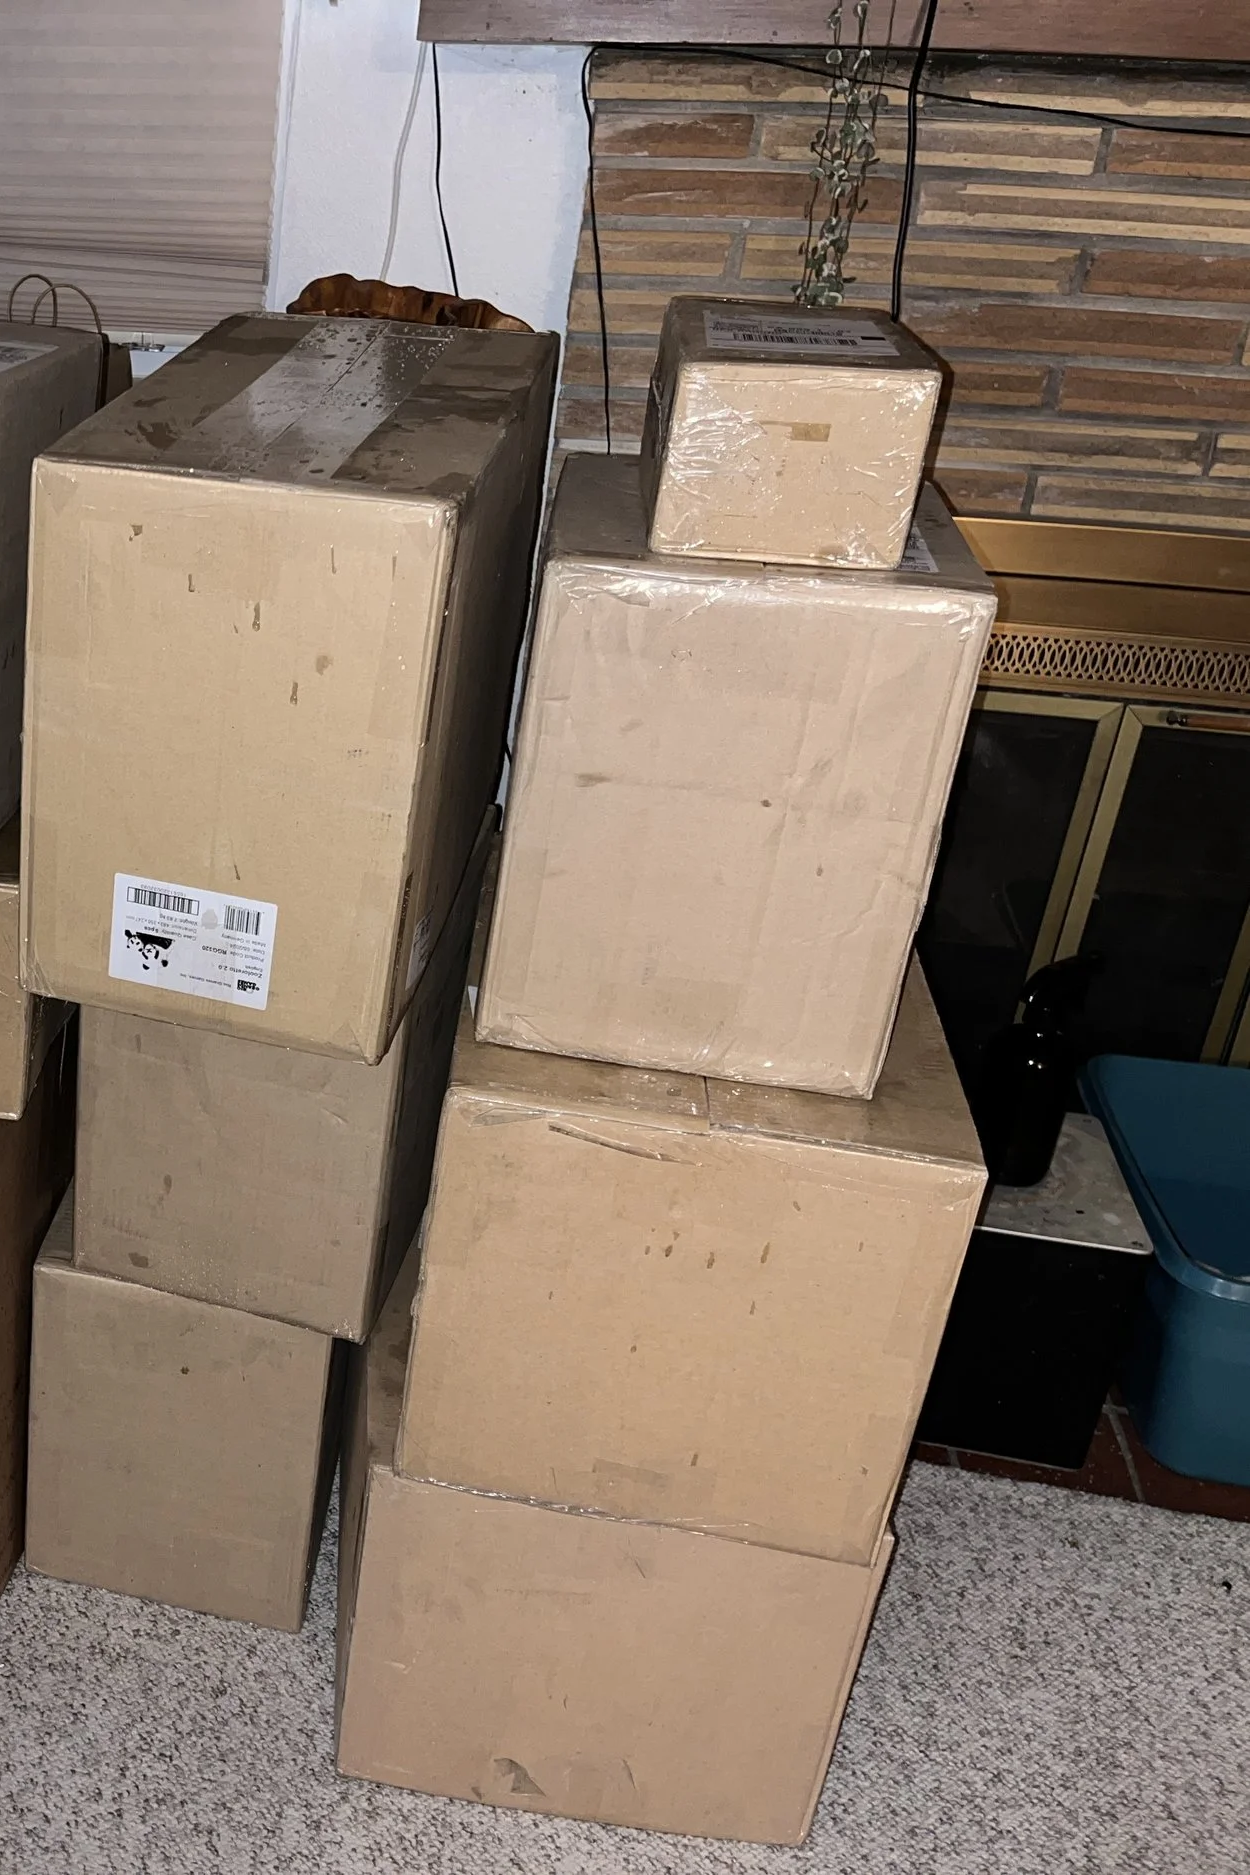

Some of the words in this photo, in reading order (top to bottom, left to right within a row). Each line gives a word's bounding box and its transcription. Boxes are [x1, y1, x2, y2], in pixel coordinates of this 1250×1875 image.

[221, 934, 244, 943] Germany
[244, 953, 264, 962] Product
[229, 966, 263, 979] Zooloretto
[244, 964, 263, 973] English
